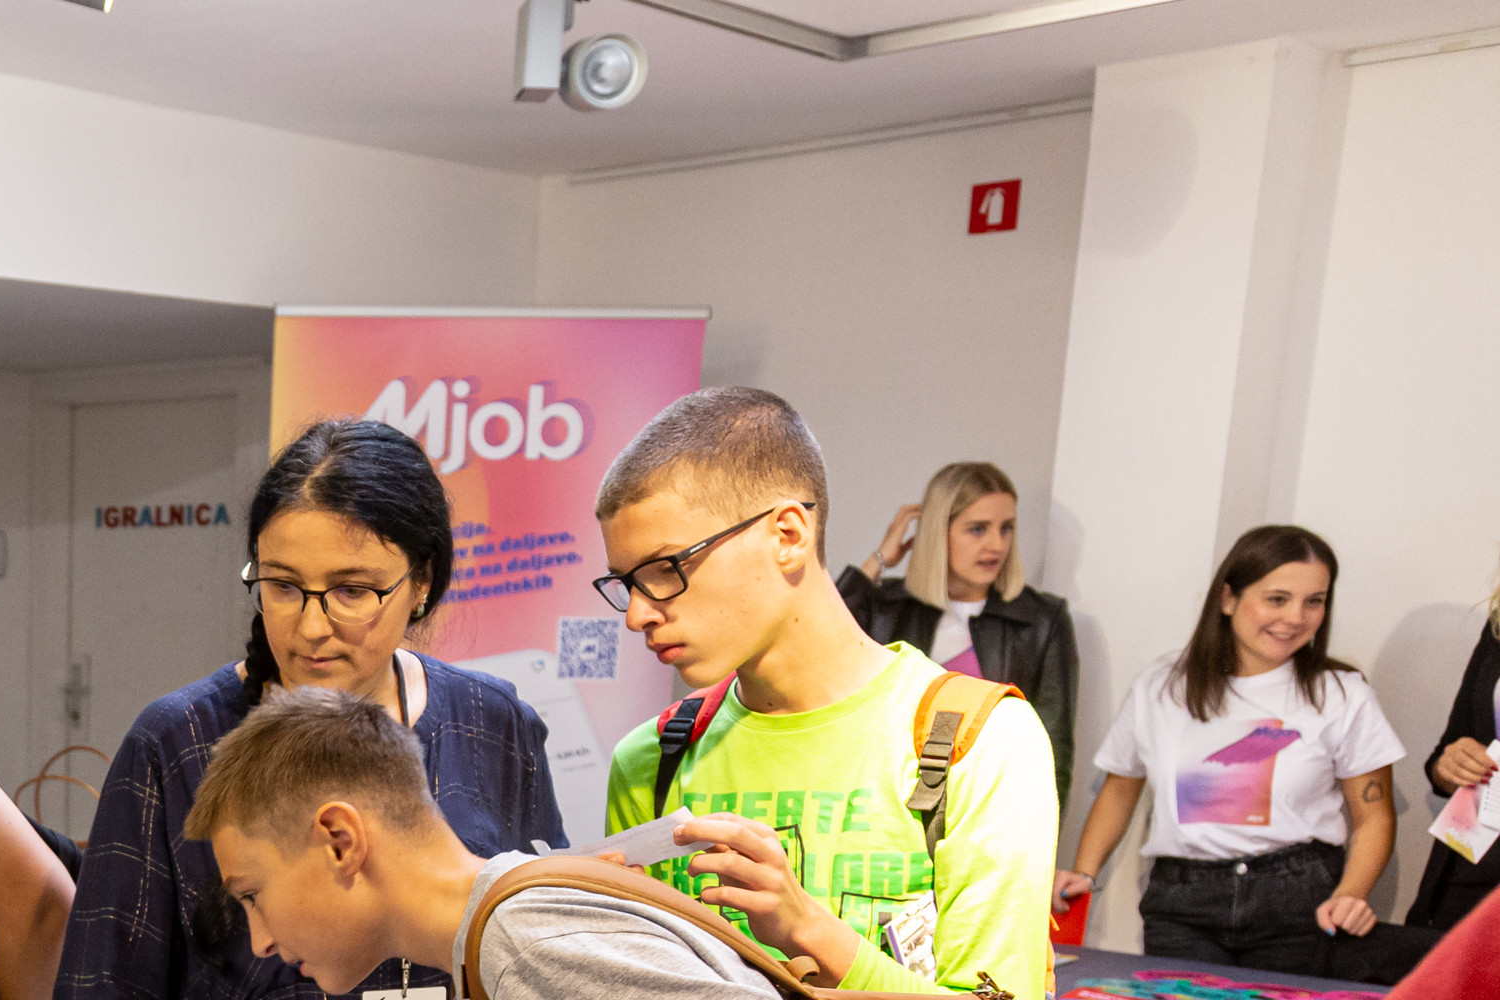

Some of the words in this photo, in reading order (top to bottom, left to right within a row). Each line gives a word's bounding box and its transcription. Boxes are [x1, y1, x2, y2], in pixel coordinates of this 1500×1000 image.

[363, 376, 585, 476] Mjob
[95, 503, 230, 529] IGRALNICA
[473, 543, 495, 557] na
[480, 562, 503, 576] na
